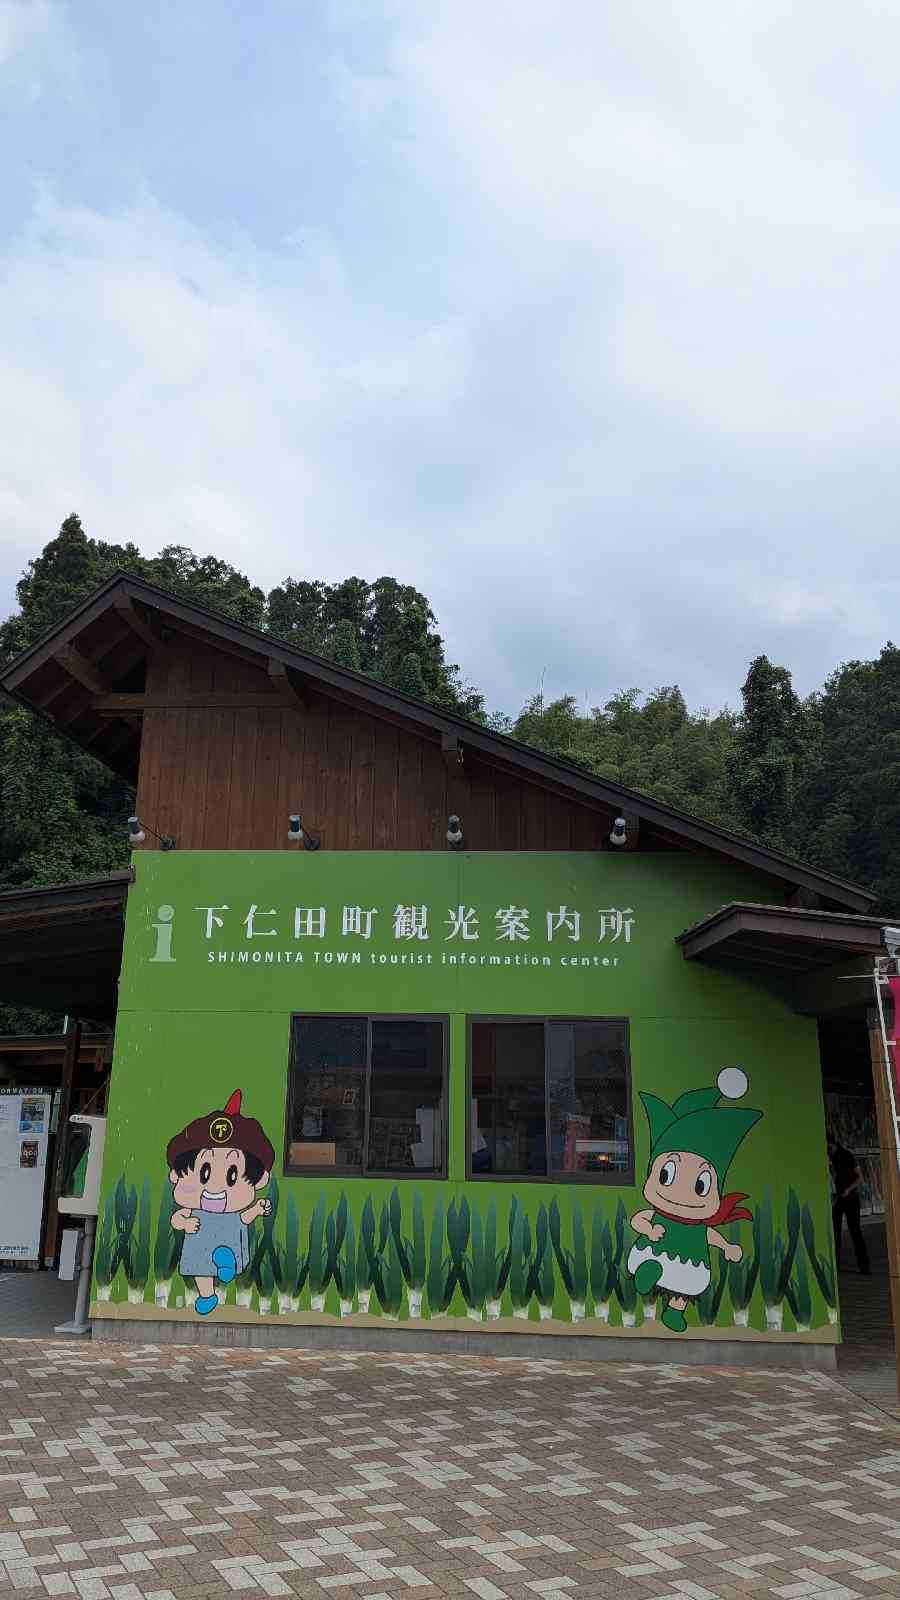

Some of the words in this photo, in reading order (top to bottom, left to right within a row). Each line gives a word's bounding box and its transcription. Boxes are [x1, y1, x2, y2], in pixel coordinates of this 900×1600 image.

[192, 904, 636, 943] 下仁田町観光案内所
[207, 951, 304, 963] SHIMONITA
[314, 952, 361, 964] TOWN
[371, 952, 433, 965] tourist
[441, 952, 551, 966] information
[560, 955, 619, 967] center
